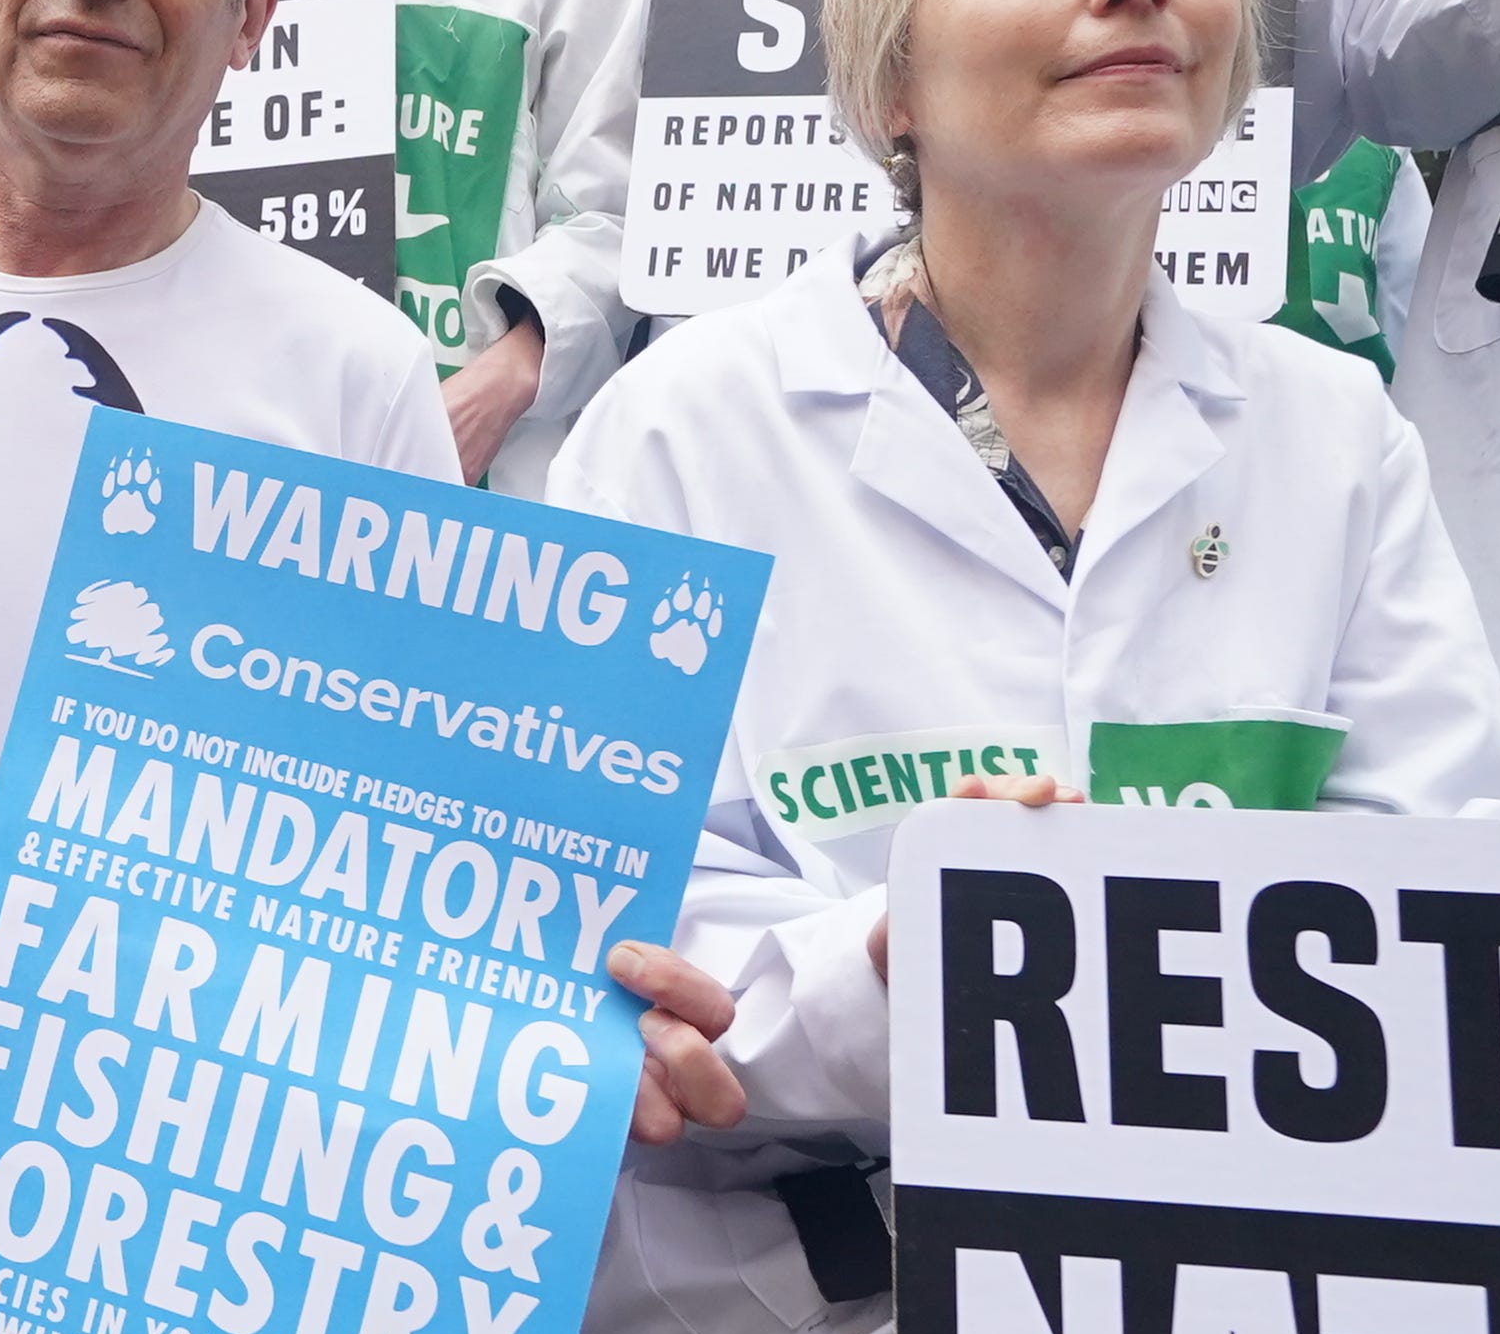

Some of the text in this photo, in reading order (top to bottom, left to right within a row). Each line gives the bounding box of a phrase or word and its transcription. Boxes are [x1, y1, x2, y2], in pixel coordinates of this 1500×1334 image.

[260, 188, 366, 240] 58%
[191, 460, 630, 647] WARNING
[190, 621, 682, 796] Conservatives
[28, 735, 639, 977] MANDATORY
